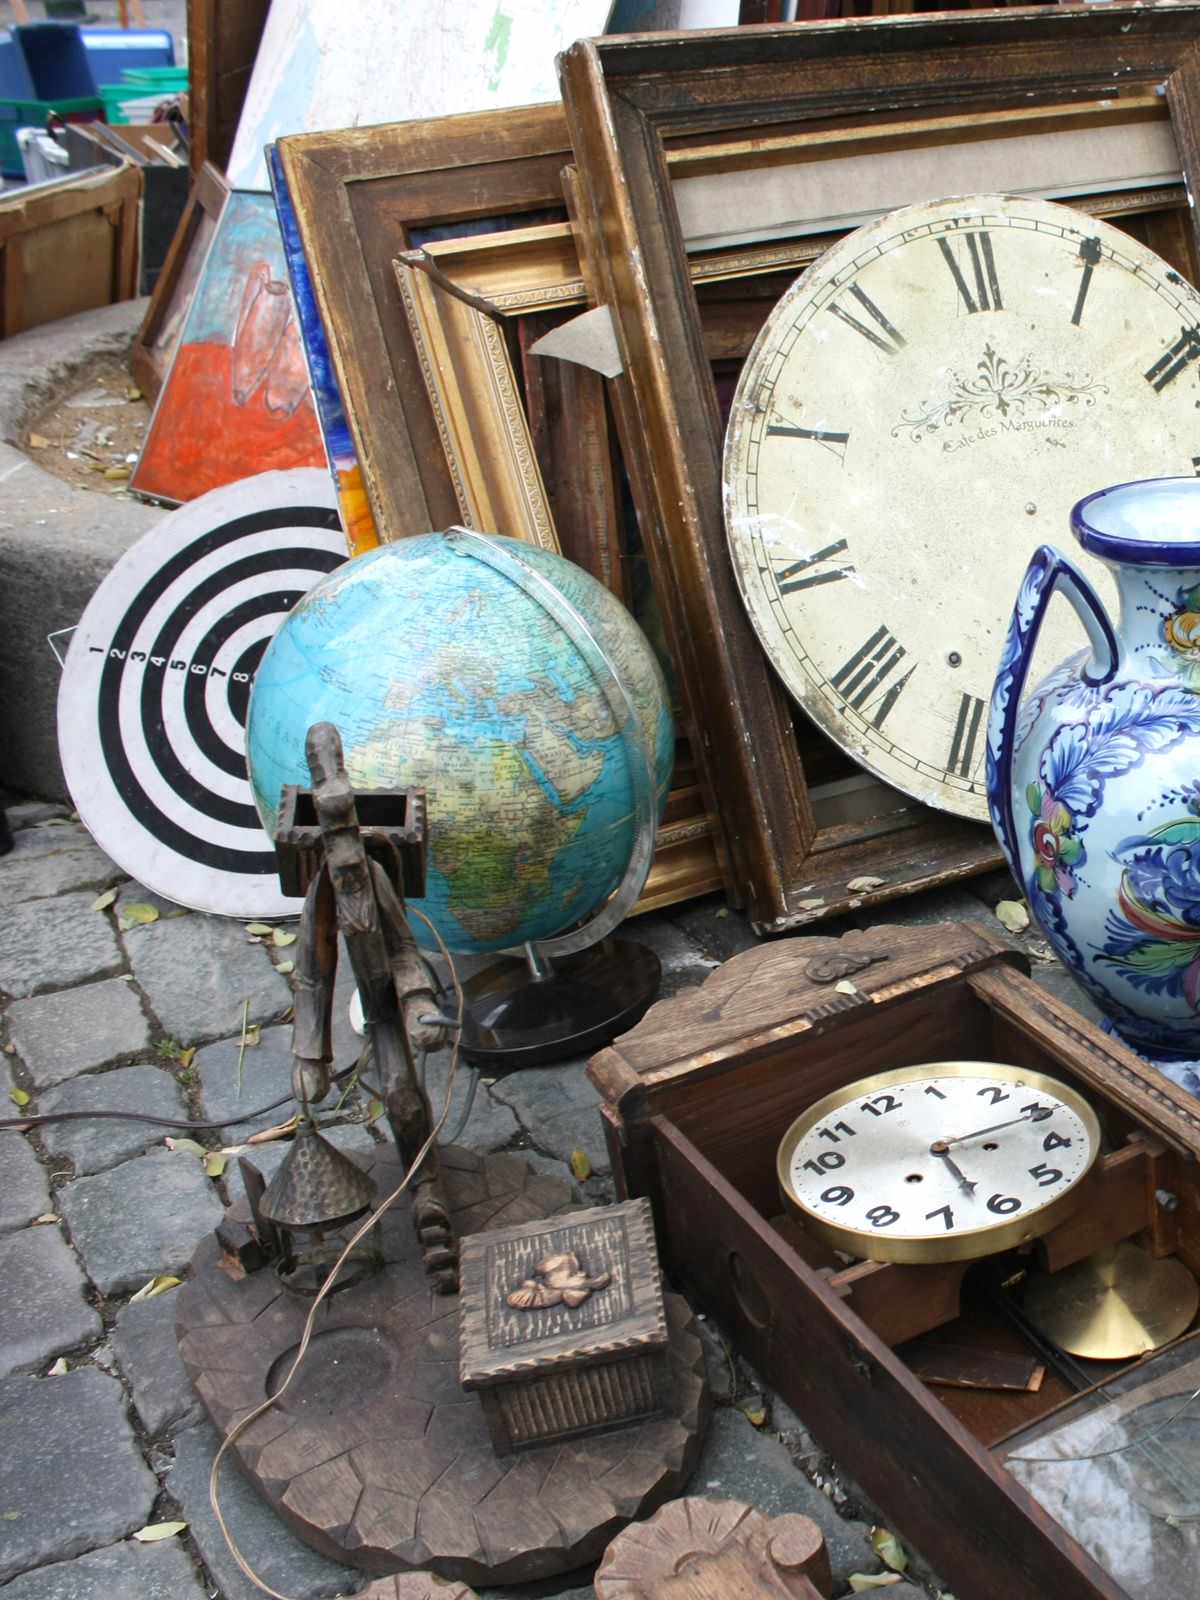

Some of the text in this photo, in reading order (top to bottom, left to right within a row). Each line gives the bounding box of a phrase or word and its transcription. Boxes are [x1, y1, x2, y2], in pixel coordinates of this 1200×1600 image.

[976, 426, 998, 440] des
[89, 645, 249, 682] 1 2 3 4 5 6 7 8
[924, 1085, 947, 1100] 1
[976, 1086, 1010, 1105] 2
[860, 1095, 903, 1117] 12
[1019, 1102, 1053, 1122] 3
[818, 1121, 857, 1143] 11
[1042, 1131, 1072, 1152] 4
[803, 1151, 846, 1176] 10
[1028, 1163, 1063, 1187] 5
[820, 1185, 855, 1206] 9
[986, 1193, 1022, 1215] 6
[865, 1205, 900, 1227] 8
[925, 1204, 954, 1230] 7
